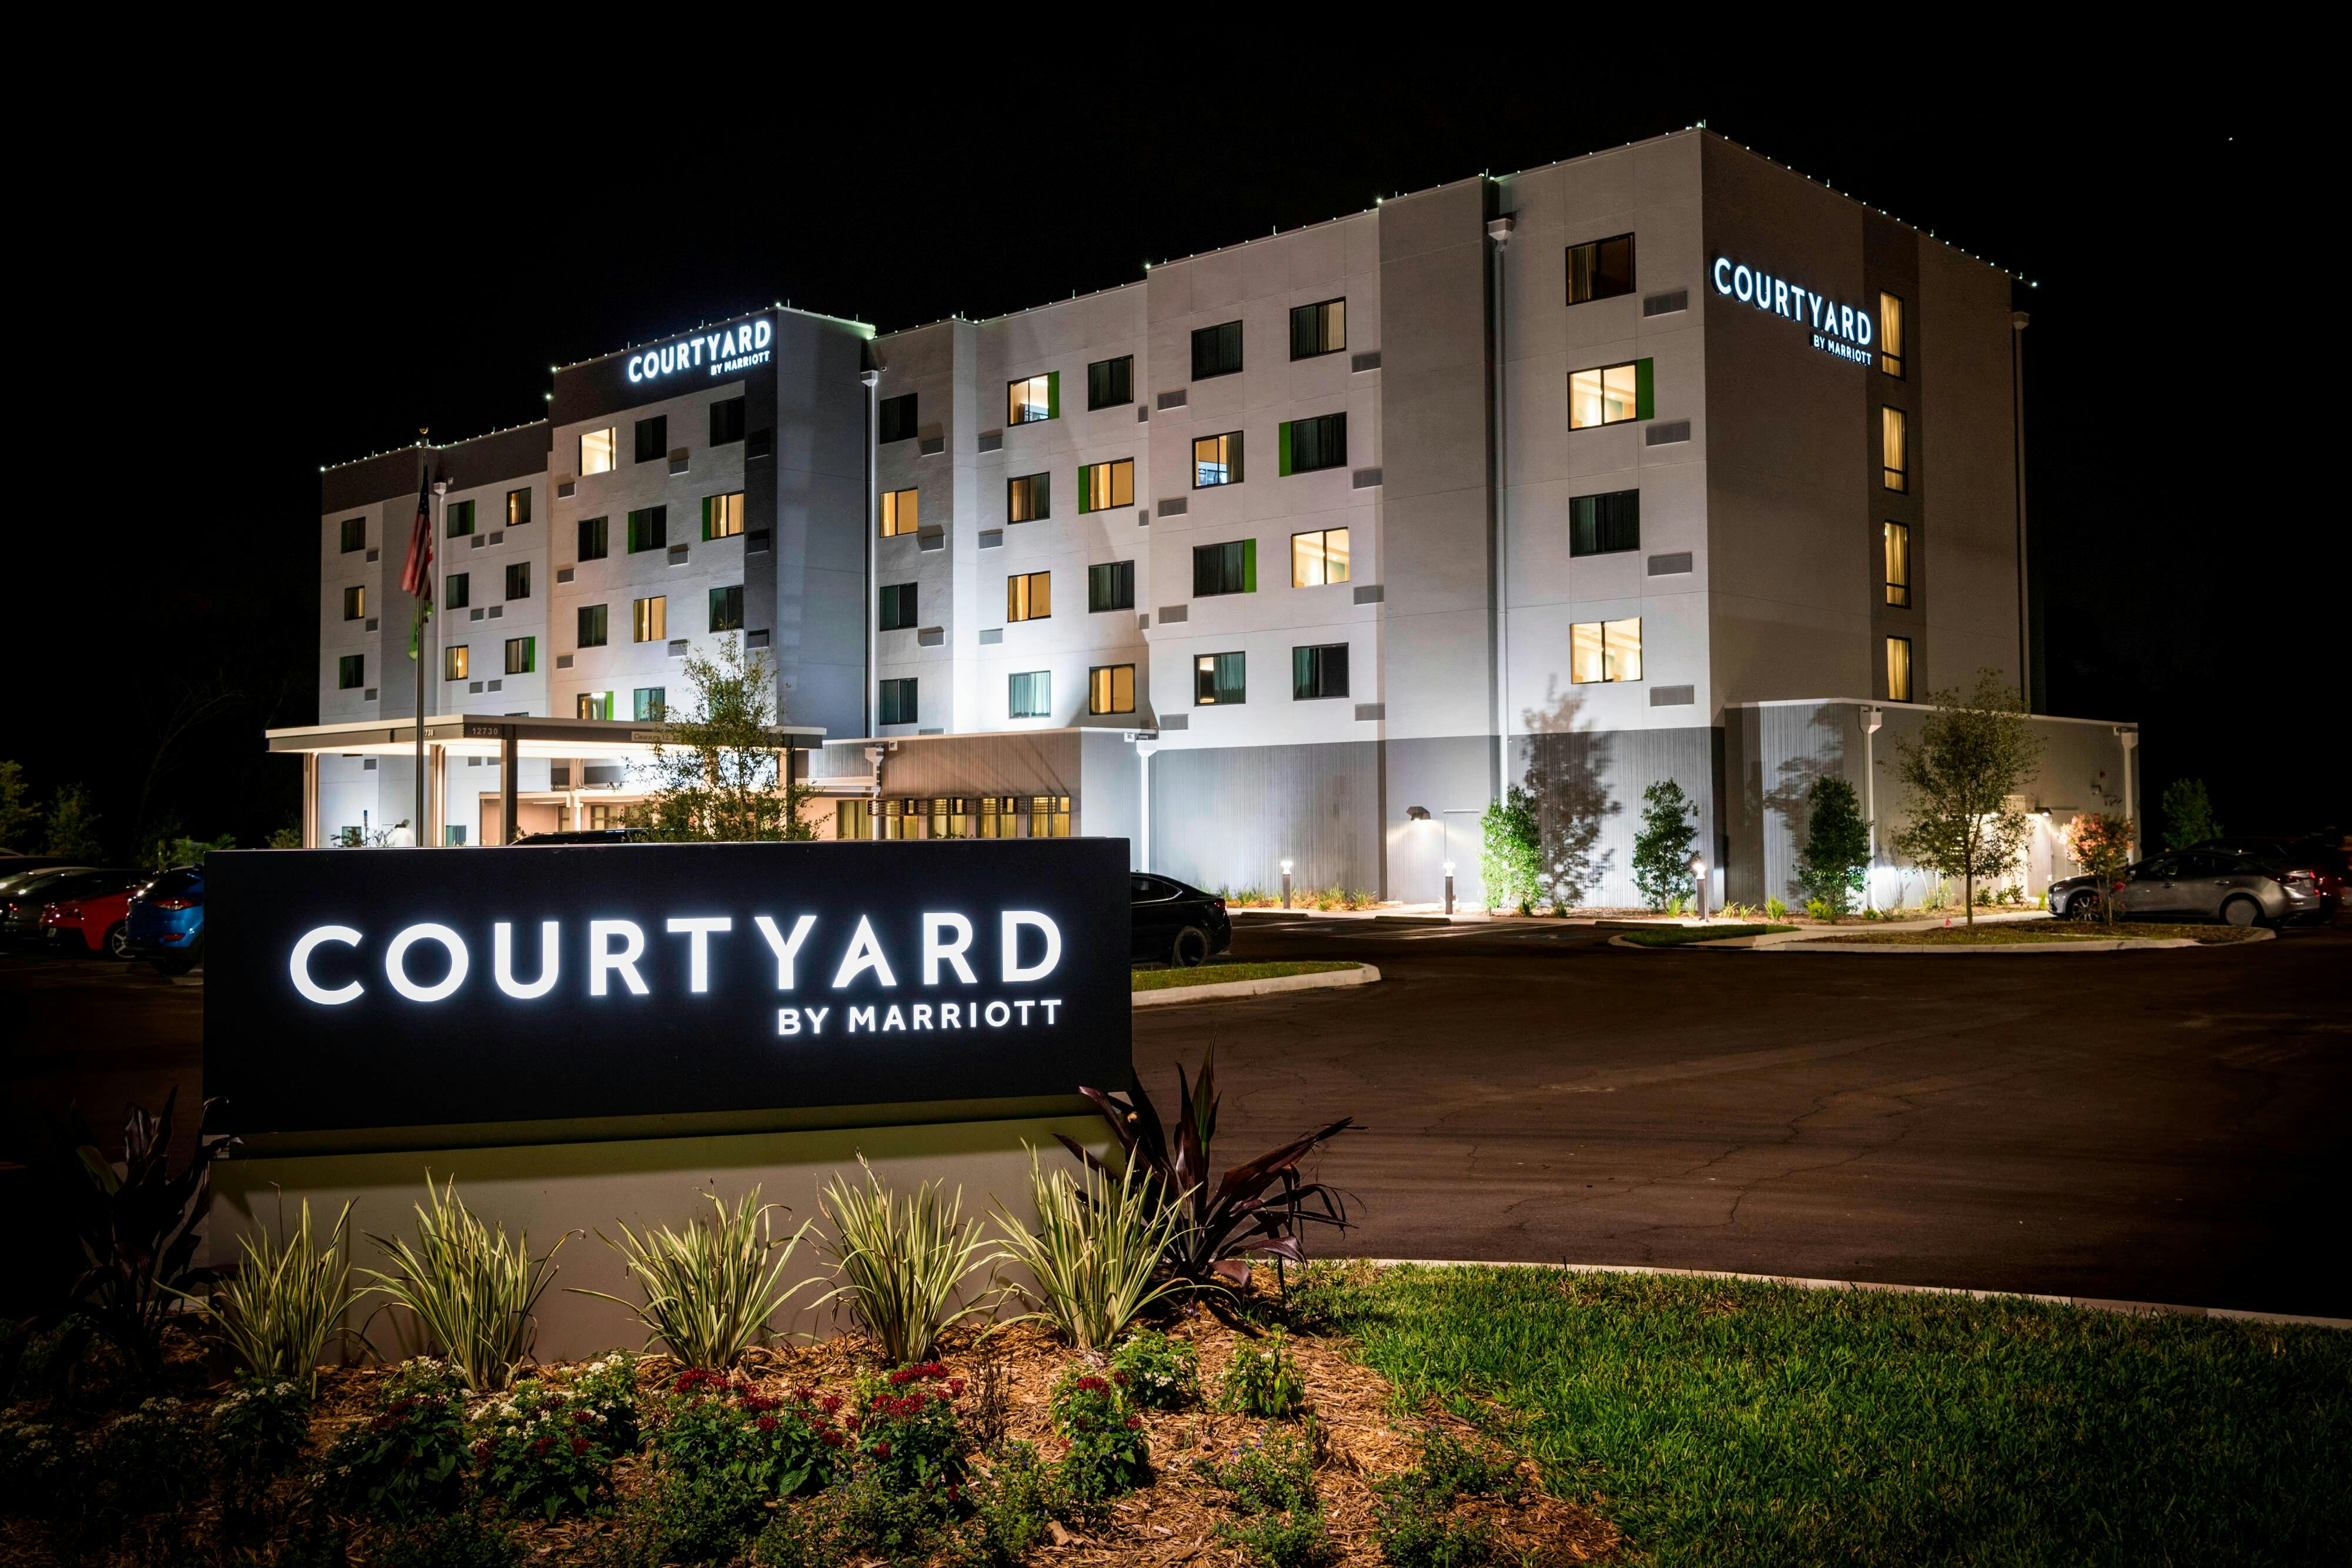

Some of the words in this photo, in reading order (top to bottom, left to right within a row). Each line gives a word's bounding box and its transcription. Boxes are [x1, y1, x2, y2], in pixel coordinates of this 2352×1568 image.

[1714, 258, 1872, 345] COURTYARD
[628, 320, 771, 383] COURTYARD
[710, 363, 723, 376] BY
[724, 350, 770, 372] MARRIOTT
[1813, 334, 1825, 349] BY
[1828, 339, 1872, 366] MARRIOTT
[290, 910, 1061, 1005] COURTYARD
[778, 1007, 830, 1035] BY
[848, 999, 1062, 1032] MARRIOTT
